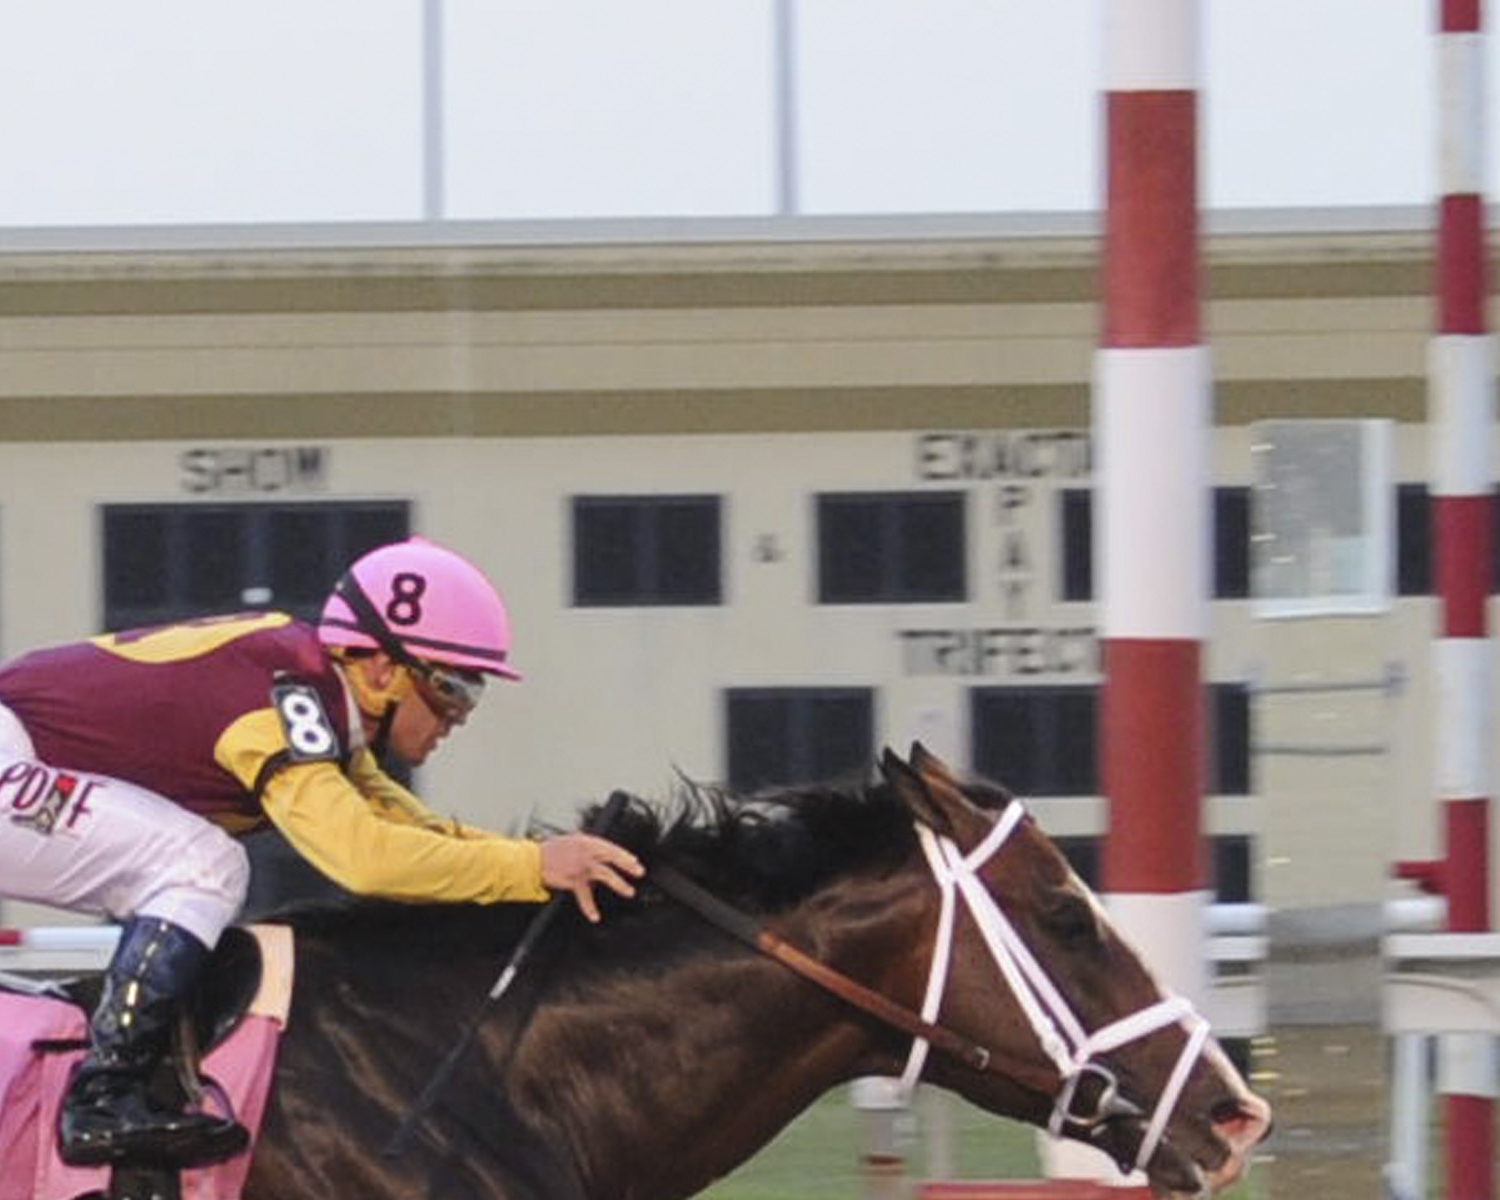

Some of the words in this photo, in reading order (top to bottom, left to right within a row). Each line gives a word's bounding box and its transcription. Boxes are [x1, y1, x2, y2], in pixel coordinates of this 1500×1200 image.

[180, 449, 329, 494] SHOW
[385, 572, 426, 626] 8
[896, 627, 1104, 676] TRIFECT
[285, 692, 334, 758] 8
